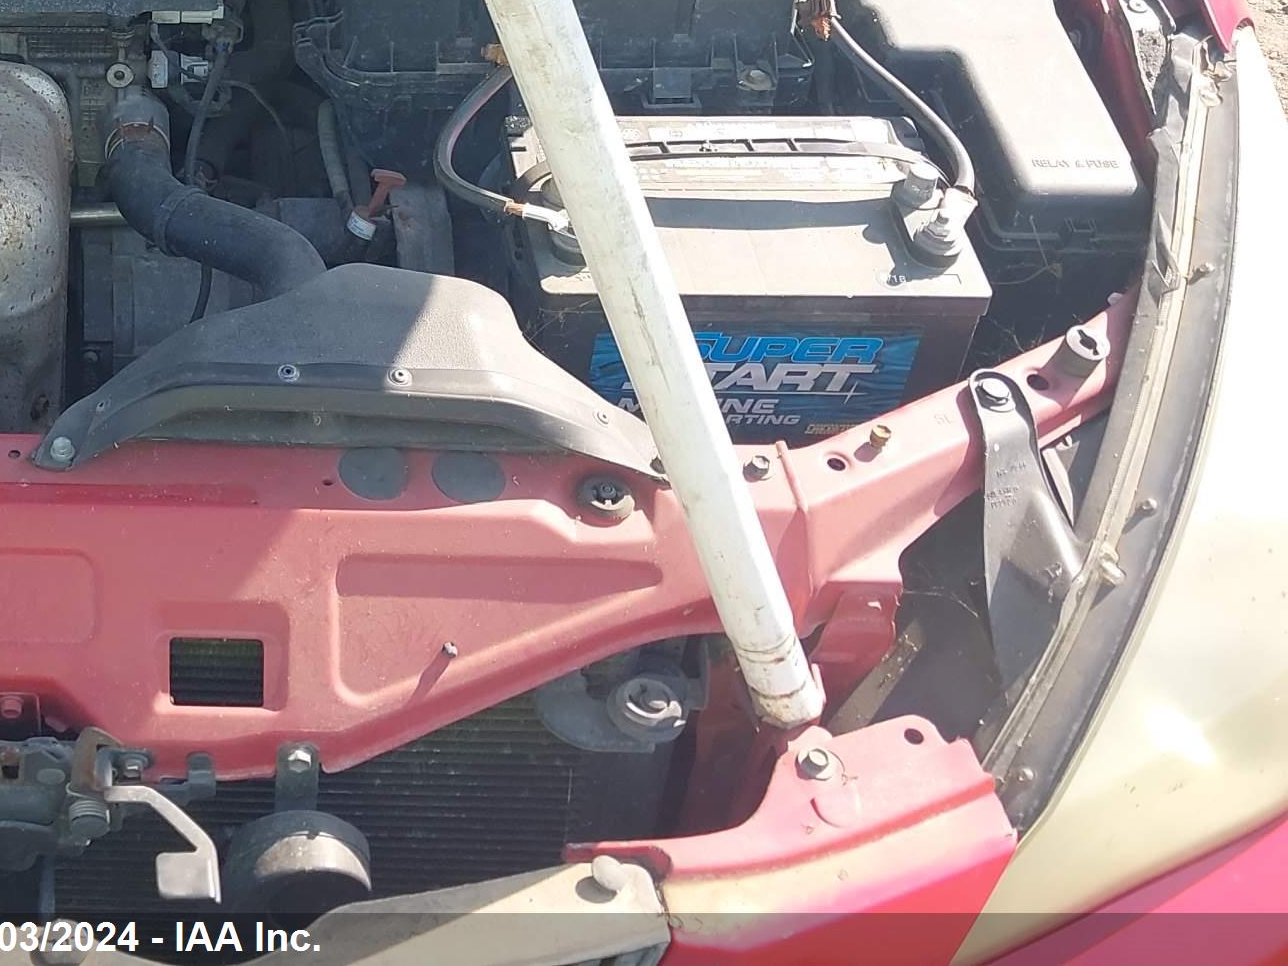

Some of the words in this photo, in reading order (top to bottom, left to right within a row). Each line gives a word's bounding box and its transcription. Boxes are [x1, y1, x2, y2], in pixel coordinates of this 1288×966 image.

[1031, 159, 1071, 168] RELAY
[1086, 159, 1120, 169] FUSE
[693, 331, 884, 364] SUPER
[622, 362, 877, 391] TART
